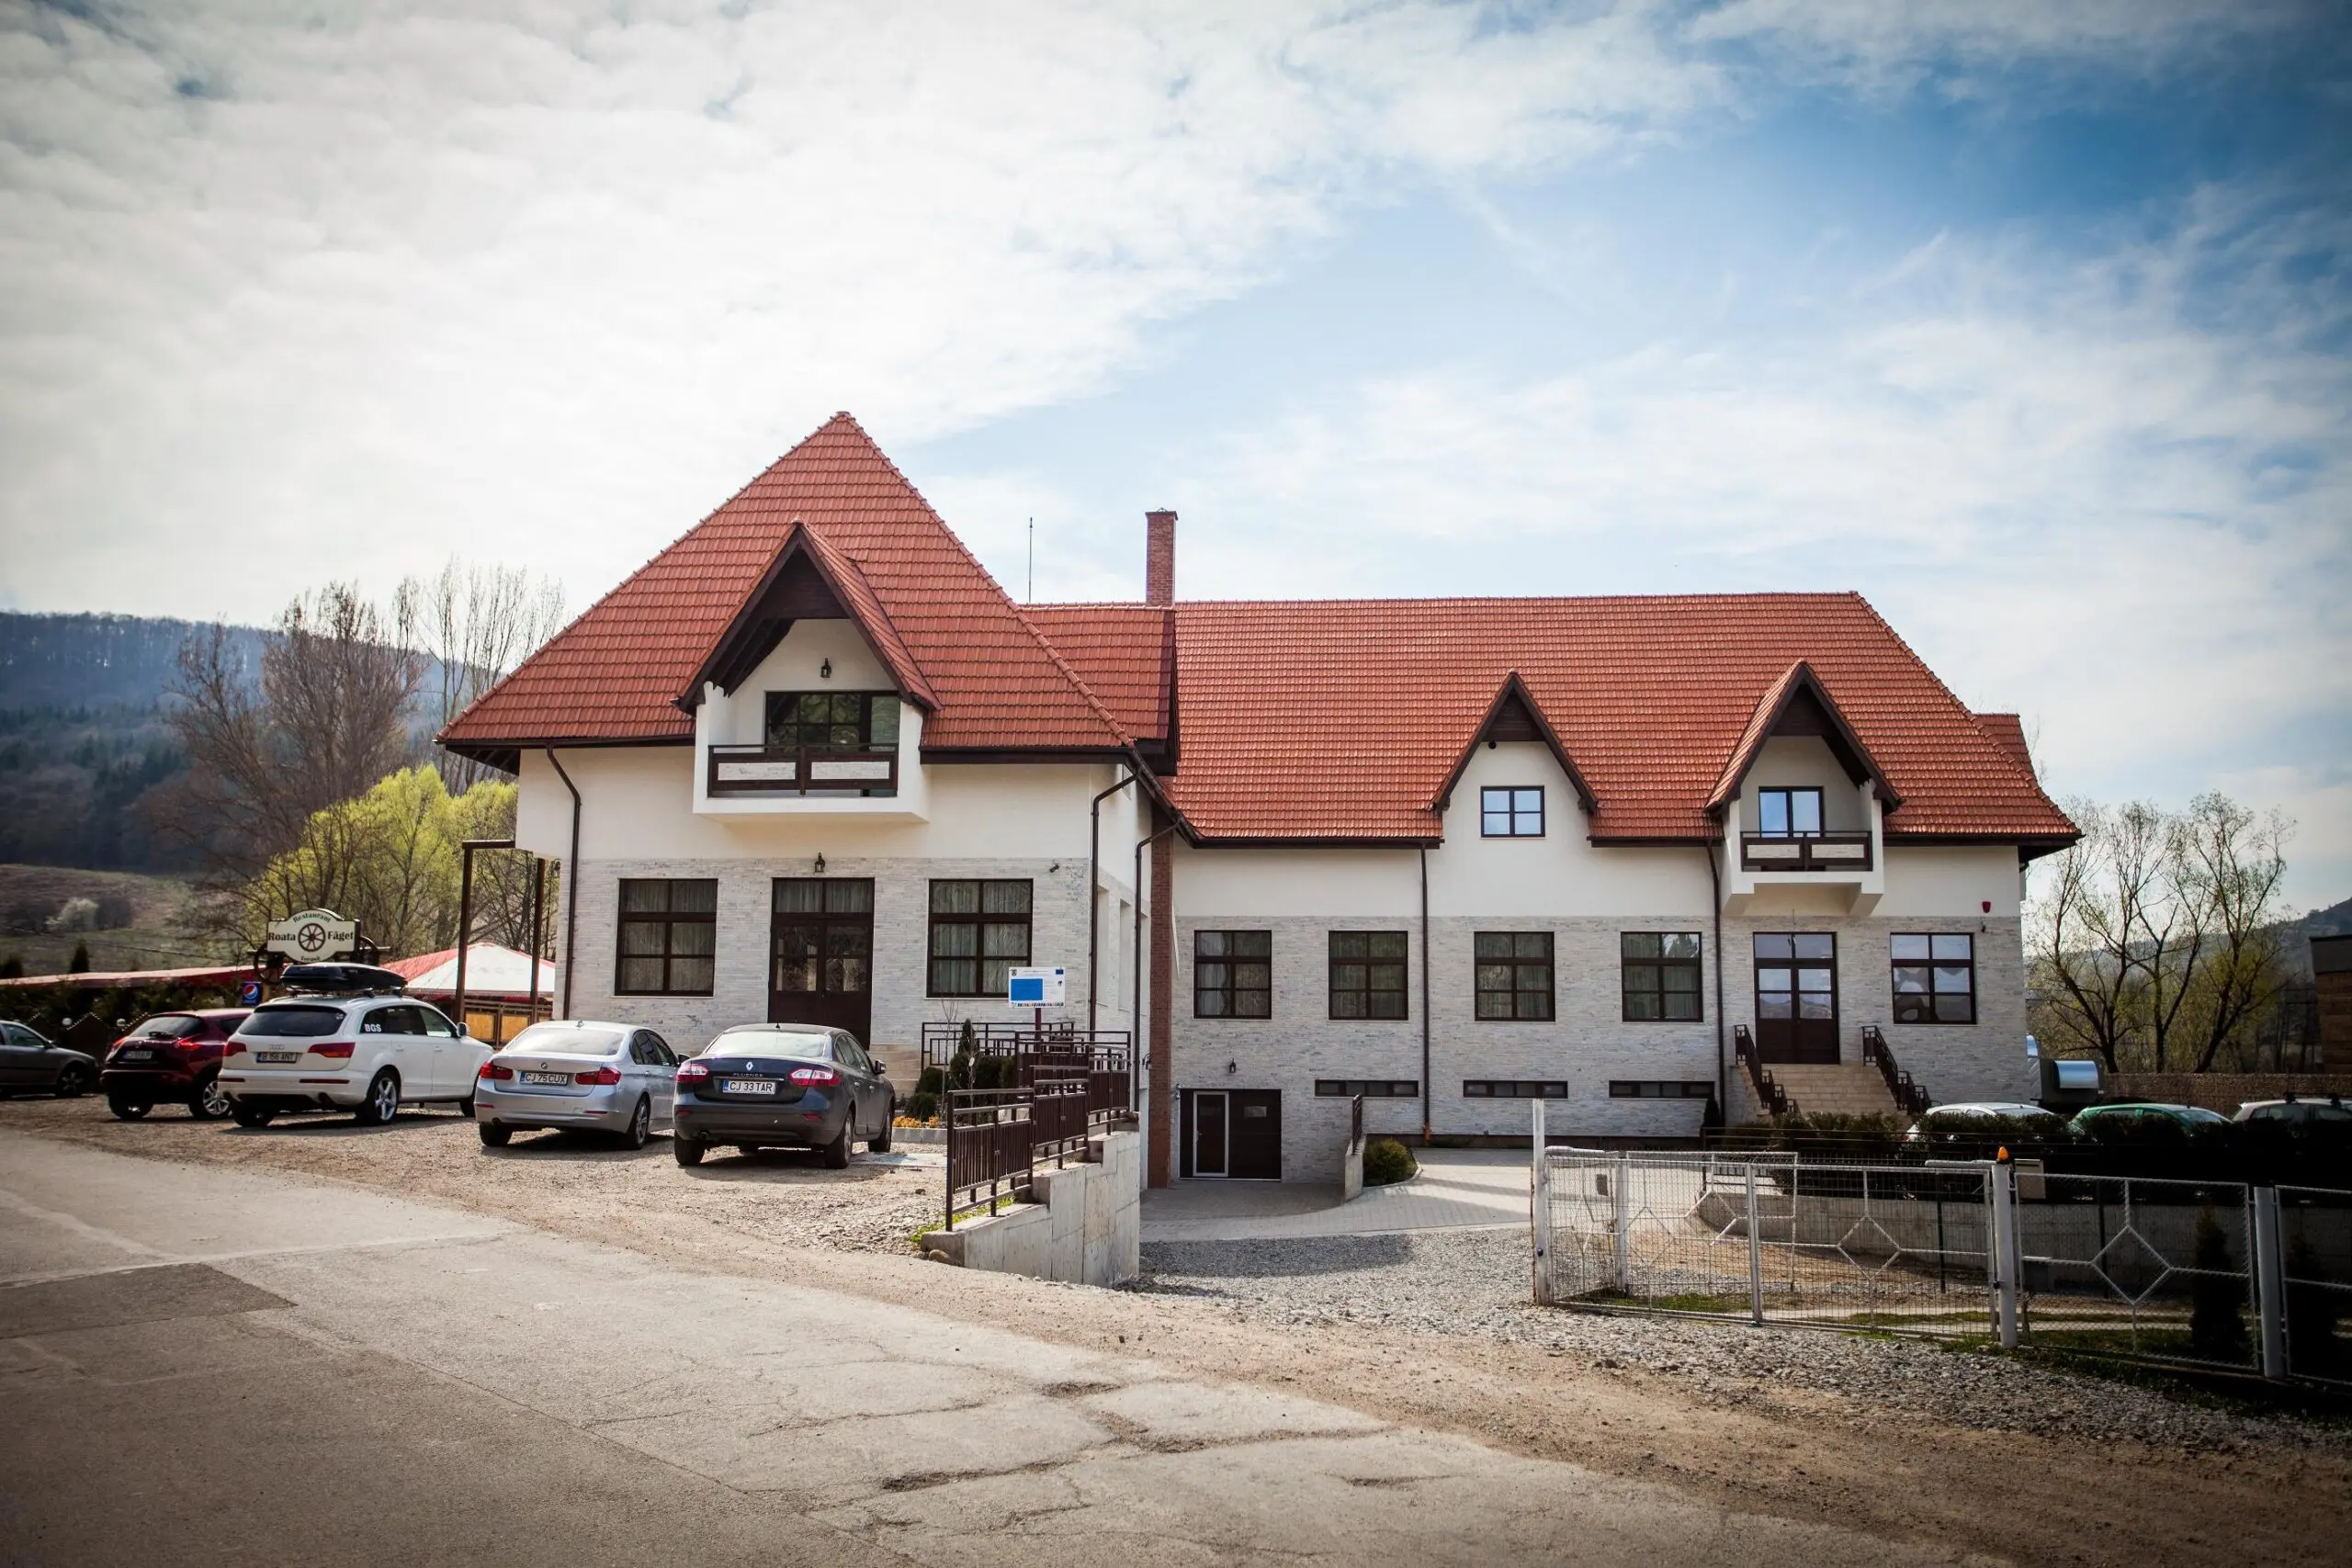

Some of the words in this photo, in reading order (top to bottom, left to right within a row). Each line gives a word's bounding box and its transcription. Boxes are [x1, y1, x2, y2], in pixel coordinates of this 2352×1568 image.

[268, 932, 296, 942] Roata
[364, 1023, 382, 1032] BGS
[526, 1073, 537, 1082] CJ
[548, 1075, 566, 1083] CUX
[729, 1082, 741, 1090] CJ
[743, 1082, 754, 1091] 33
[755, 1082, 774, 1092] TAR
